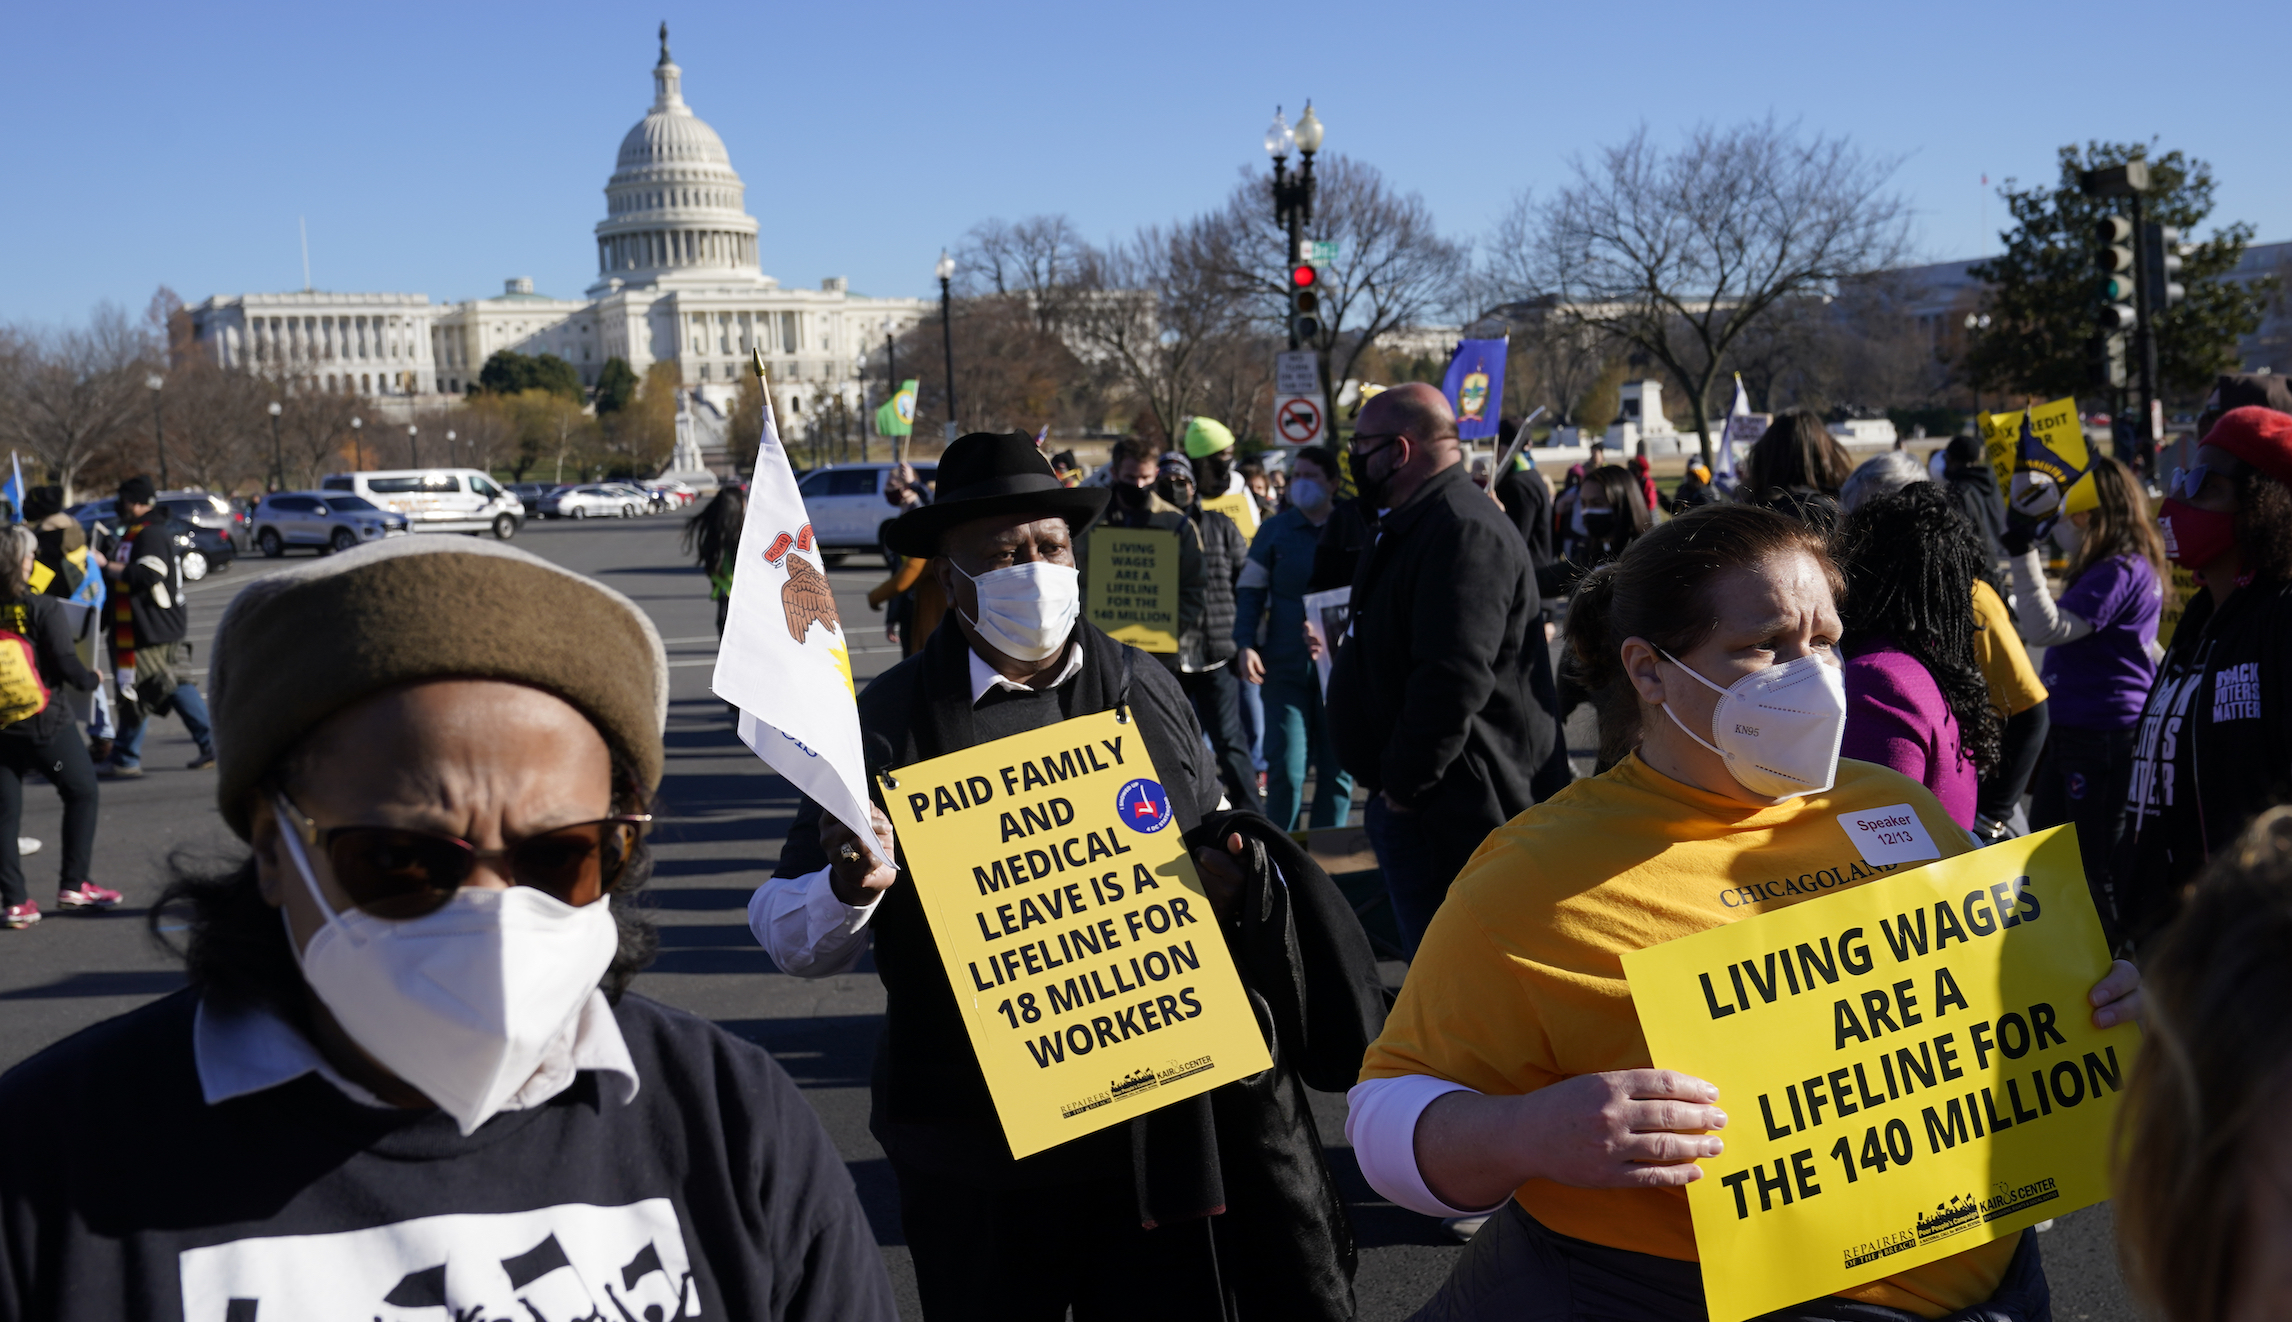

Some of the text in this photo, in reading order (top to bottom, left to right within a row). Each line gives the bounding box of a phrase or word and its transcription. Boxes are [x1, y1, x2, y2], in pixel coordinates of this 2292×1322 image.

[1112, 543, 1155, 554] LIVING
[1111, 557, 1155, 568] WAGES
[1116, 570, 1151, 581] ARE A
[1106, 583, 1158, 595] LIFELINE
[1107, 597, 1157, 608] FOR THE
[1094, 610, 1171, 623] 140 MILLION
[2215, 682, 2260, 705] VOTERS
[2213, 701, 2261, 723] MATTER
[1735, 724, 1759, 737] KN95
[908, 737, 1124, 823] PAID FAMILY
[1000, 797, 1074, 843] AND
[1857, 813, 1912, 832] Speaker
[1877, 830, 1913, 846] 12/13
[972, 827, 1131, 896] MEDICAL
[976, 863, 1159, 942] LEAVE IS A
[968, 898, 1197, 992] LIFELINE FOR
[1698, 927, 1874, 1020] LIVING
[1879, 875, 2041, 962] WAGES
[998, 940, 1200, 1029] 18 MILLION
[1834, 967, 1968, 1050] ARE A
[1025, 987, 1203, 1069] WORKERS
[1185, 1055, 1212, 1070] CENTER
[1757, 1002, 2066, 1141] LIFELINE FOR
[1060, 1091, 1110, 1113] REPAIRERS
[1721, 1046, 2124, 1220] THE 140 MILLION
[2018, 1178, 2056, 1199] CENTER
[1919, 1211, 1978, 1238] Poor People's Campaign
[1843, 1228, 1914, 1260] REPAIRERS
[1845, 1239, 1915, 1268] OF THE BREACH
